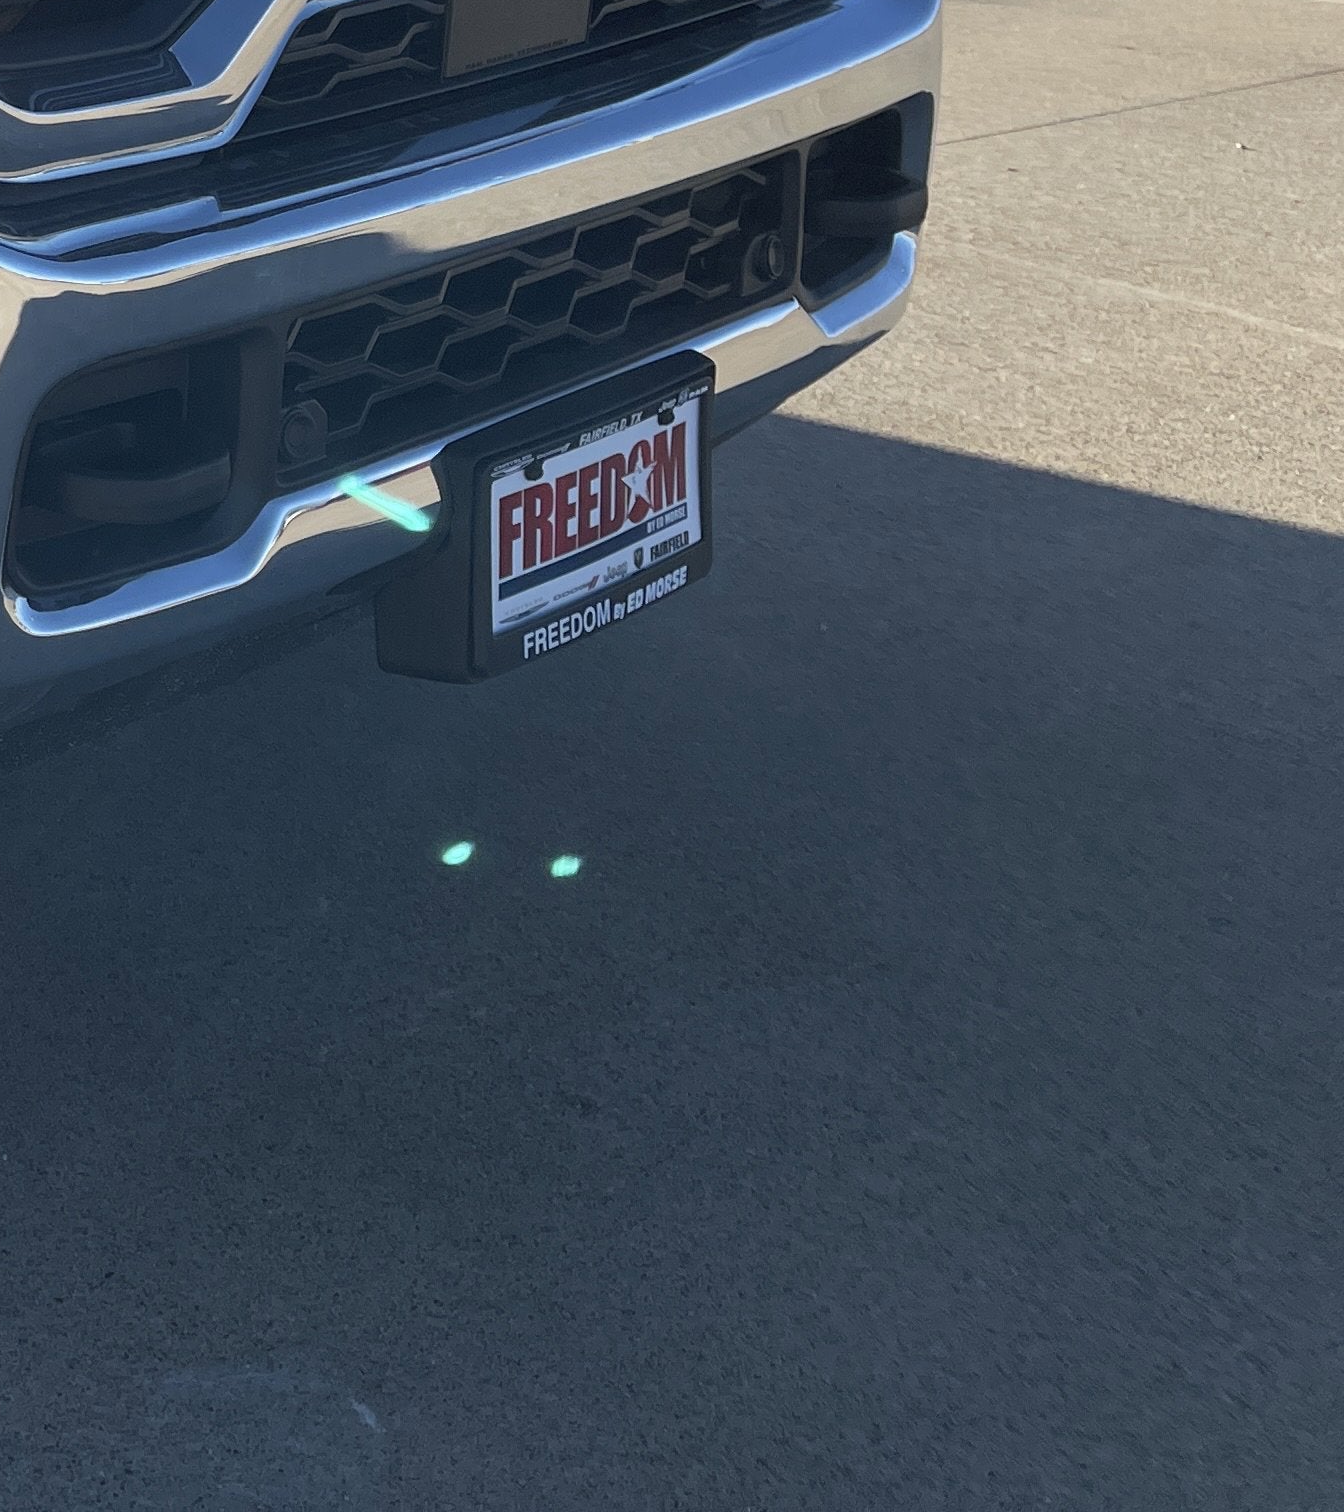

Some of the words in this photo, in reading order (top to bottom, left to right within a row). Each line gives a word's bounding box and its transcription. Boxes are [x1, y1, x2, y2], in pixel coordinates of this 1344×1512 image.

[630, 410, 644, 426] TX
[499, 421, 687, 580] FREEDOM
[650, 530, 690, 563] FAIRFIELD
[603, 561, 628, 583] Jeep
[523, 597, 611, 660] FREEDOM
[627, 587, 645, 615] ED
[644, 565, 689, 605] MORSE
